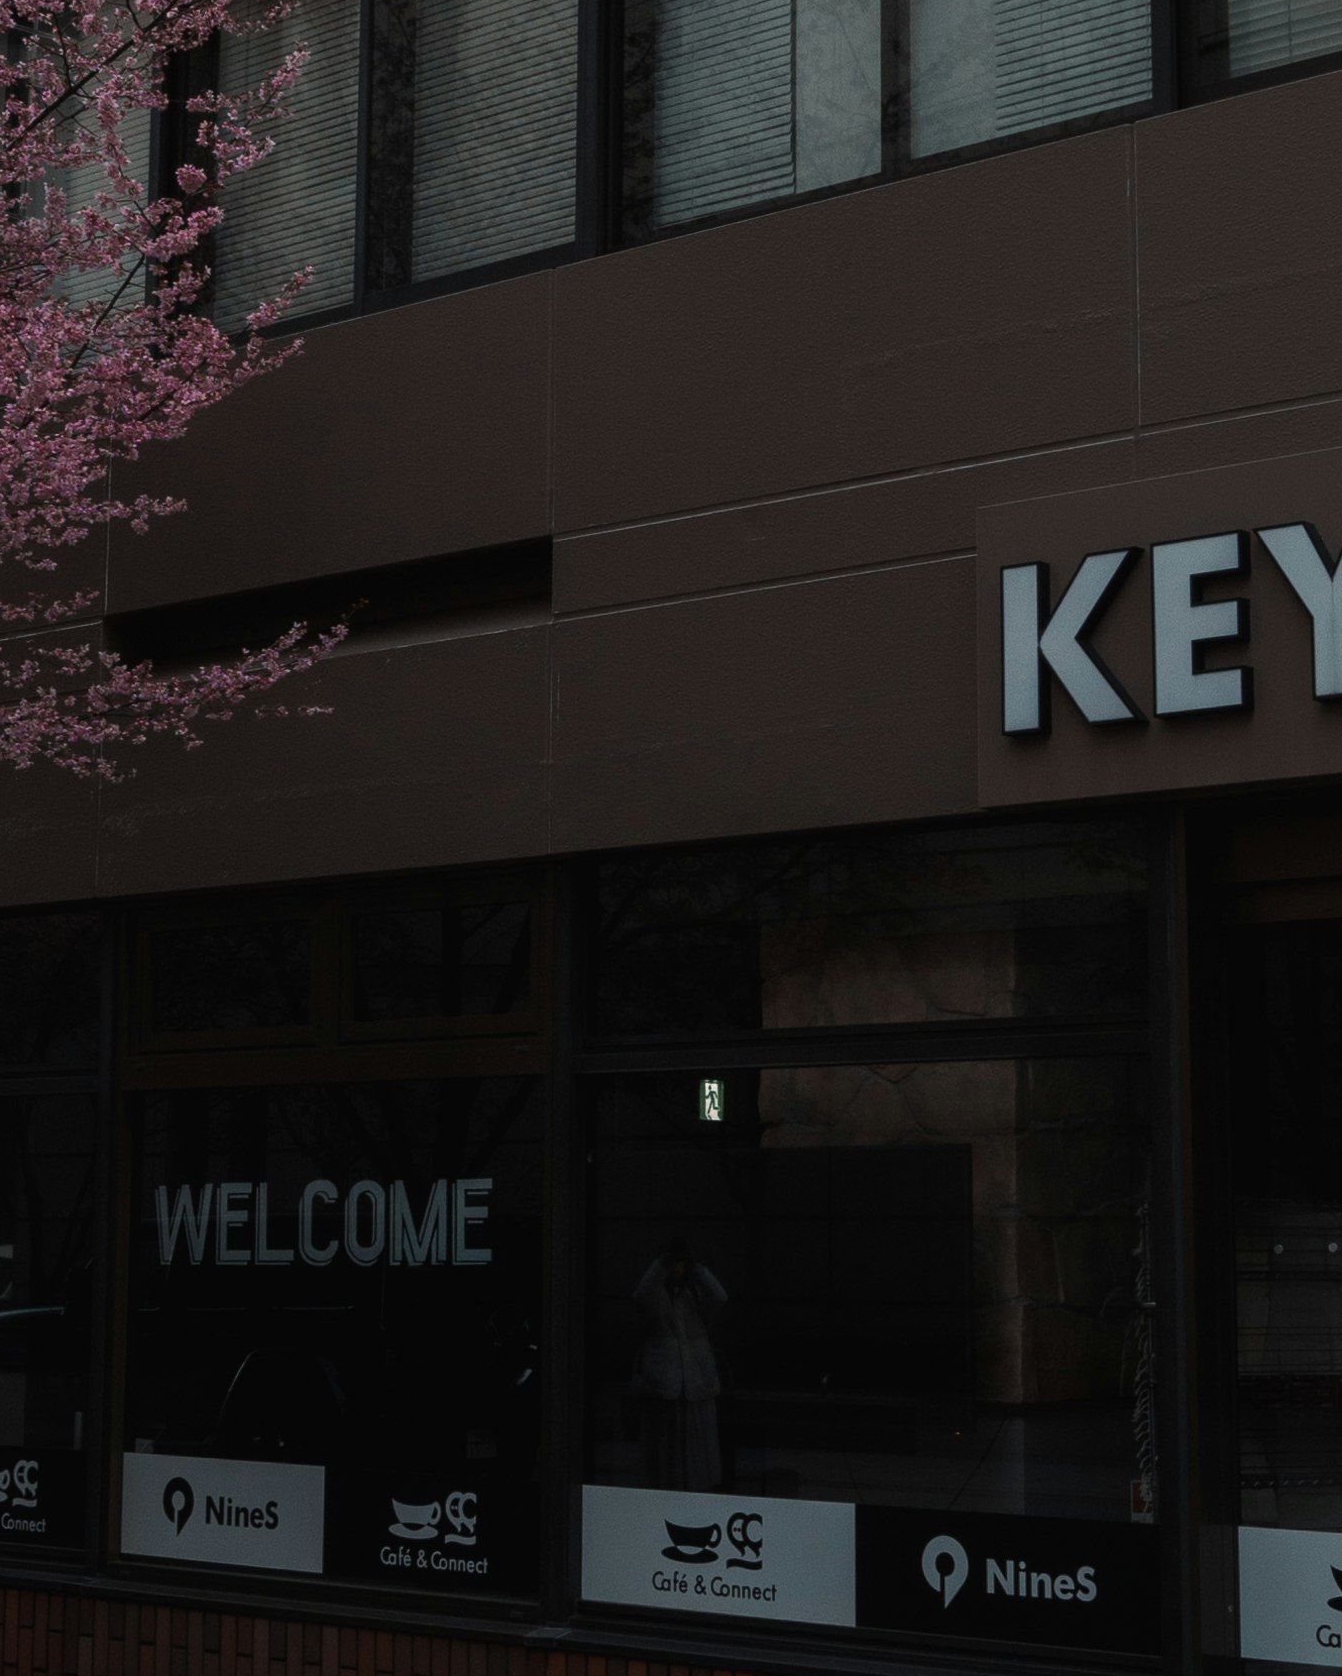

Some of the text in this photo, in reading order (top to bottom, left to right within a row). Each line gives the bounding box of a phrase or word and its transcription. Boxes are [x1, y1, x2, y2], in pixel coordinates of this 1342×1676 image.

[155, 1177, 494, 1267] WELCOME
[1, 1512, 46, 1533] Connect
[205, 1495, 279, 1529] NineS
[379, 1546, 488, 1574] Café & Connect
[651, 1570, 777, 1601] Café & Connect
[986, 1558, 1098, 1602] NineS
